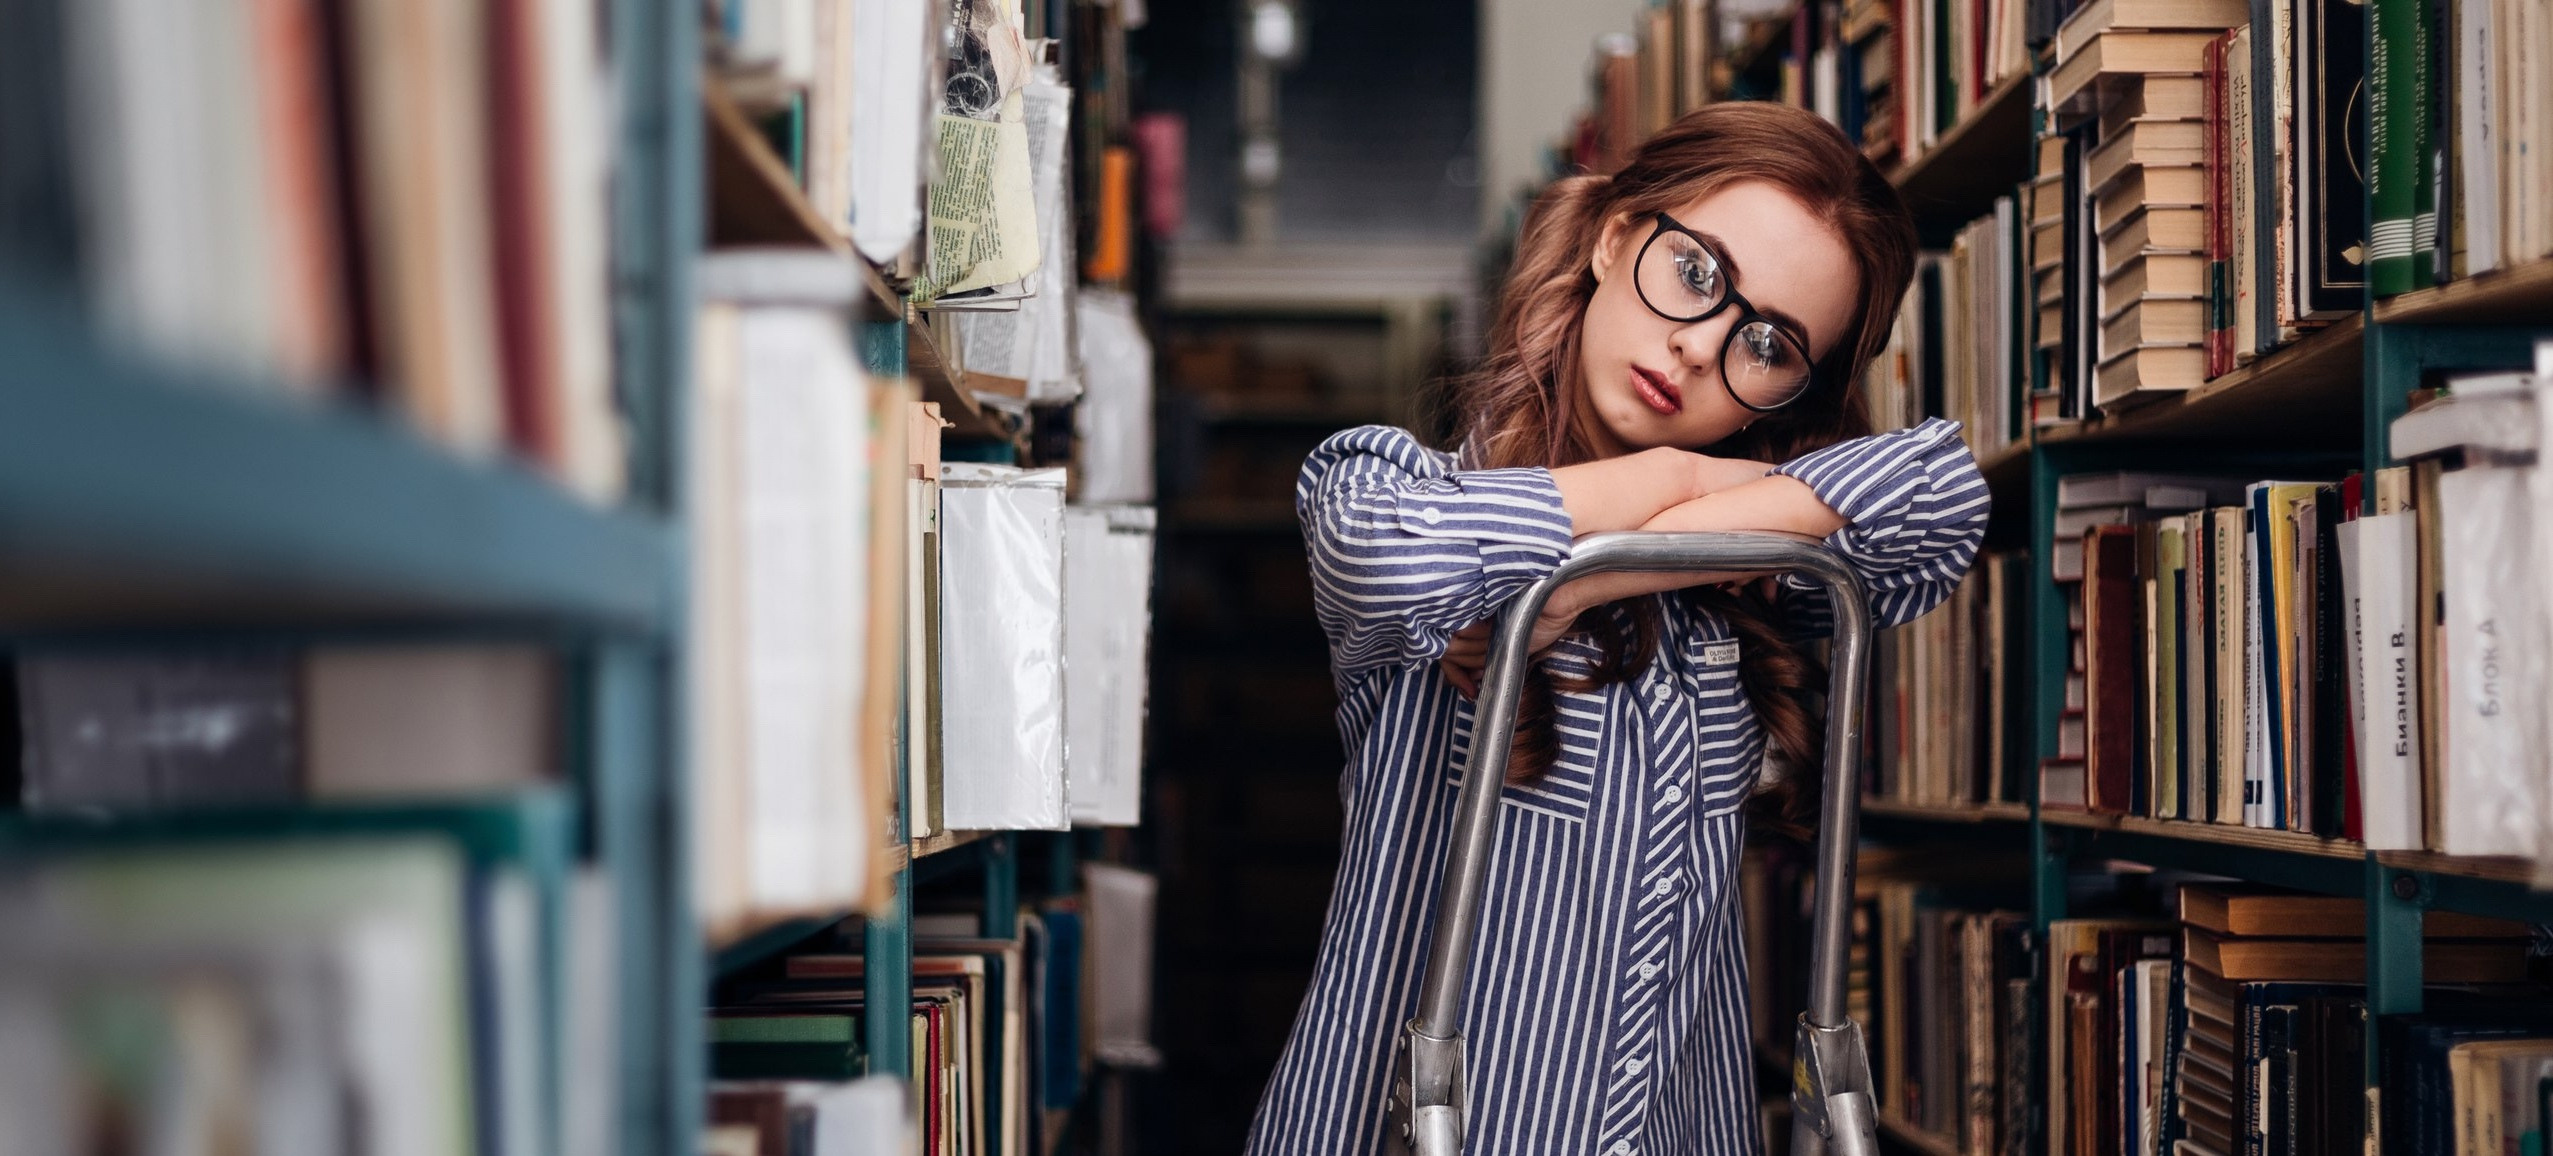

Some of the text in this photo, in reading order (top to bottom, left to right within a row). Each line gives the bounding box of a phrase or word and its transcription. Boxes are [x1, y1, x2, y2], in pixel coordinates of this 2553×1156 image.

[2391, 623, 2409, 758] Бианки В.
[2478, 645, 2501, 718] Блок
